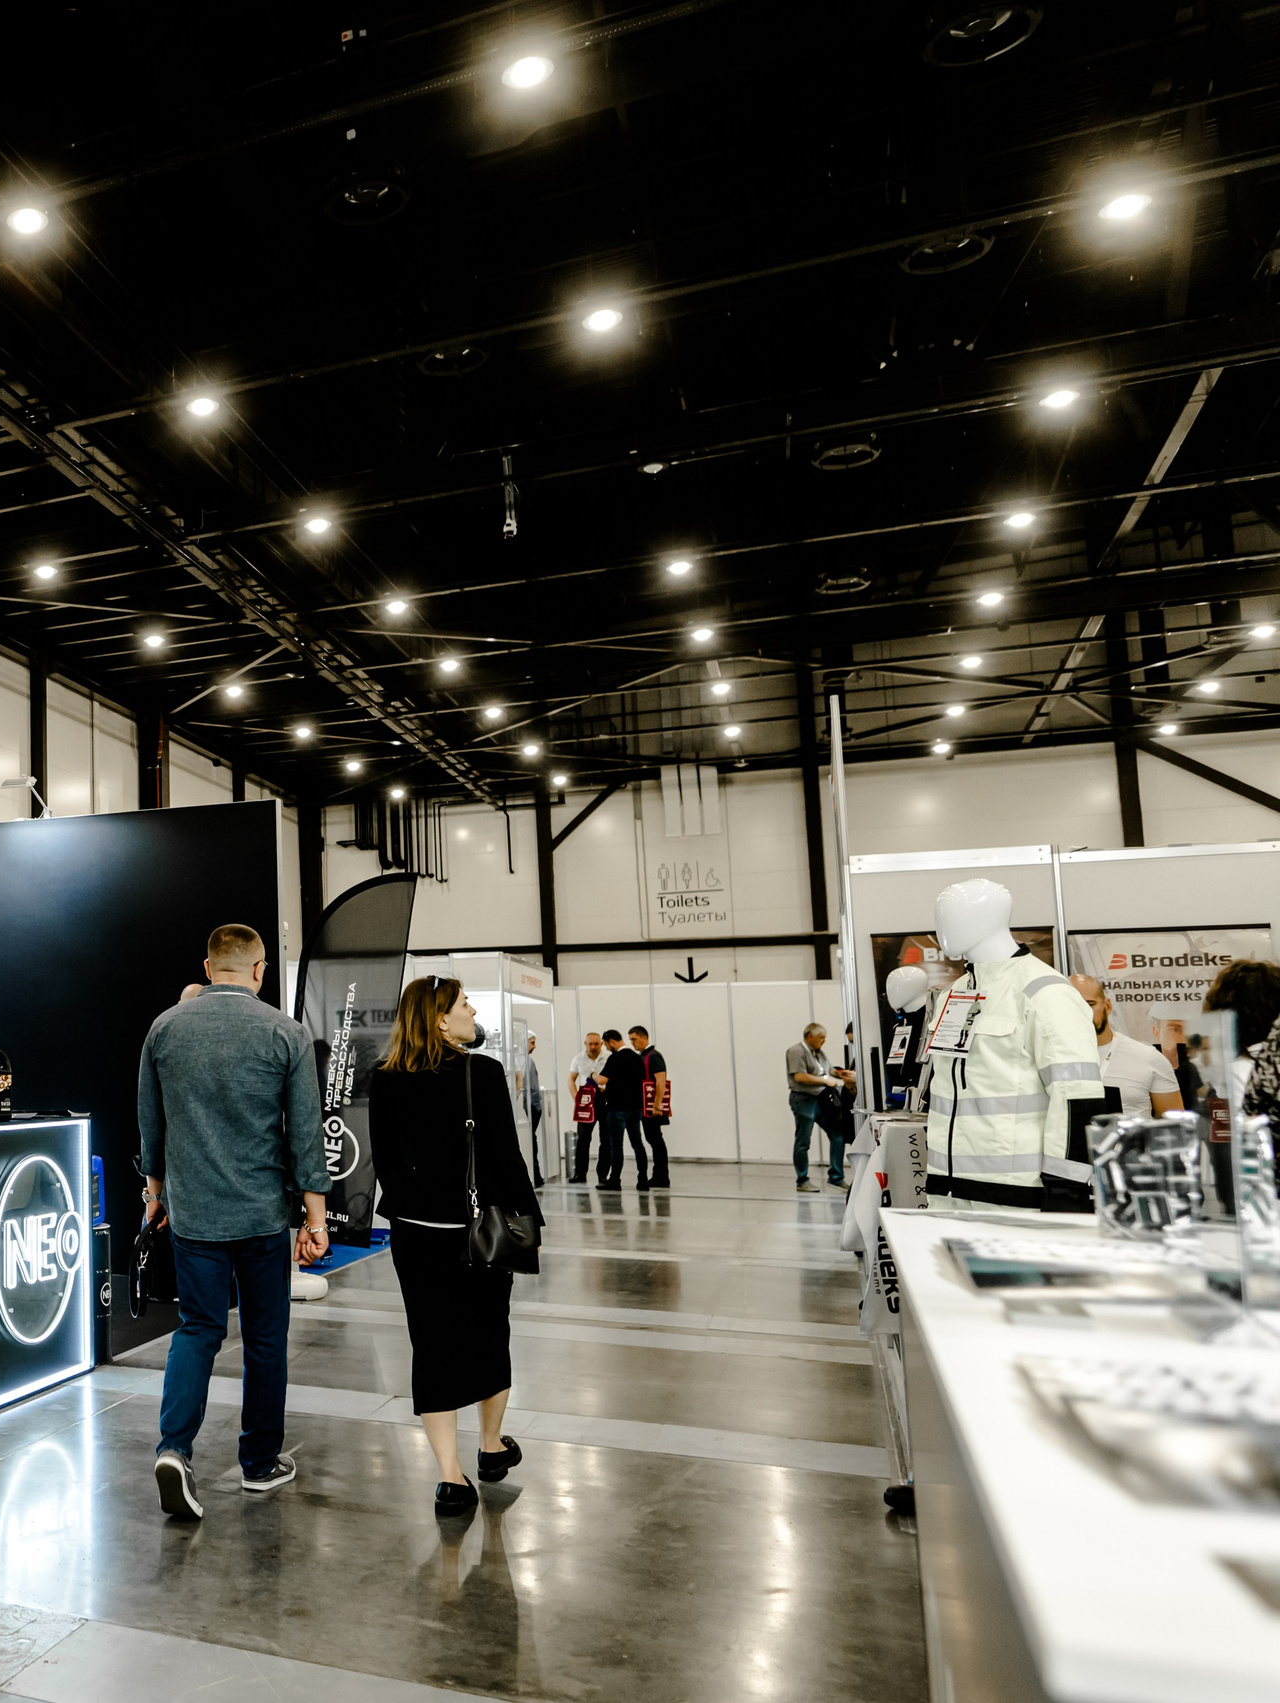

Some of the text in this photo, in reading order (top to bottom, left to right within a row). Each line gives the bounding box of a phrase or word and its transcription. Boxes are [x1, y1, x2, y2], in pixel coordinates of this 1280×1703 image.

[657, 895, 710, 908] Toilets
[658, 911, 727, 928] Туалеты
[1131, 952, 1232, 968] Brodeks
[1115, 992, 1202, 1003] BRODEKS KS
[332, 982, 357, 1108] ПРЕВОСХОДСТВА
[324, 1029, 341, 1111] МОЛЕКУЛЫ
[344, 1068, 355, 1097] NSA
[323, 1115, 345, 1173] NEO
[908, 1133, 925, 1178] work
[301, 1205, 349, 1222] NIL.RU
[3, 1211, 85, 1289] NEO
